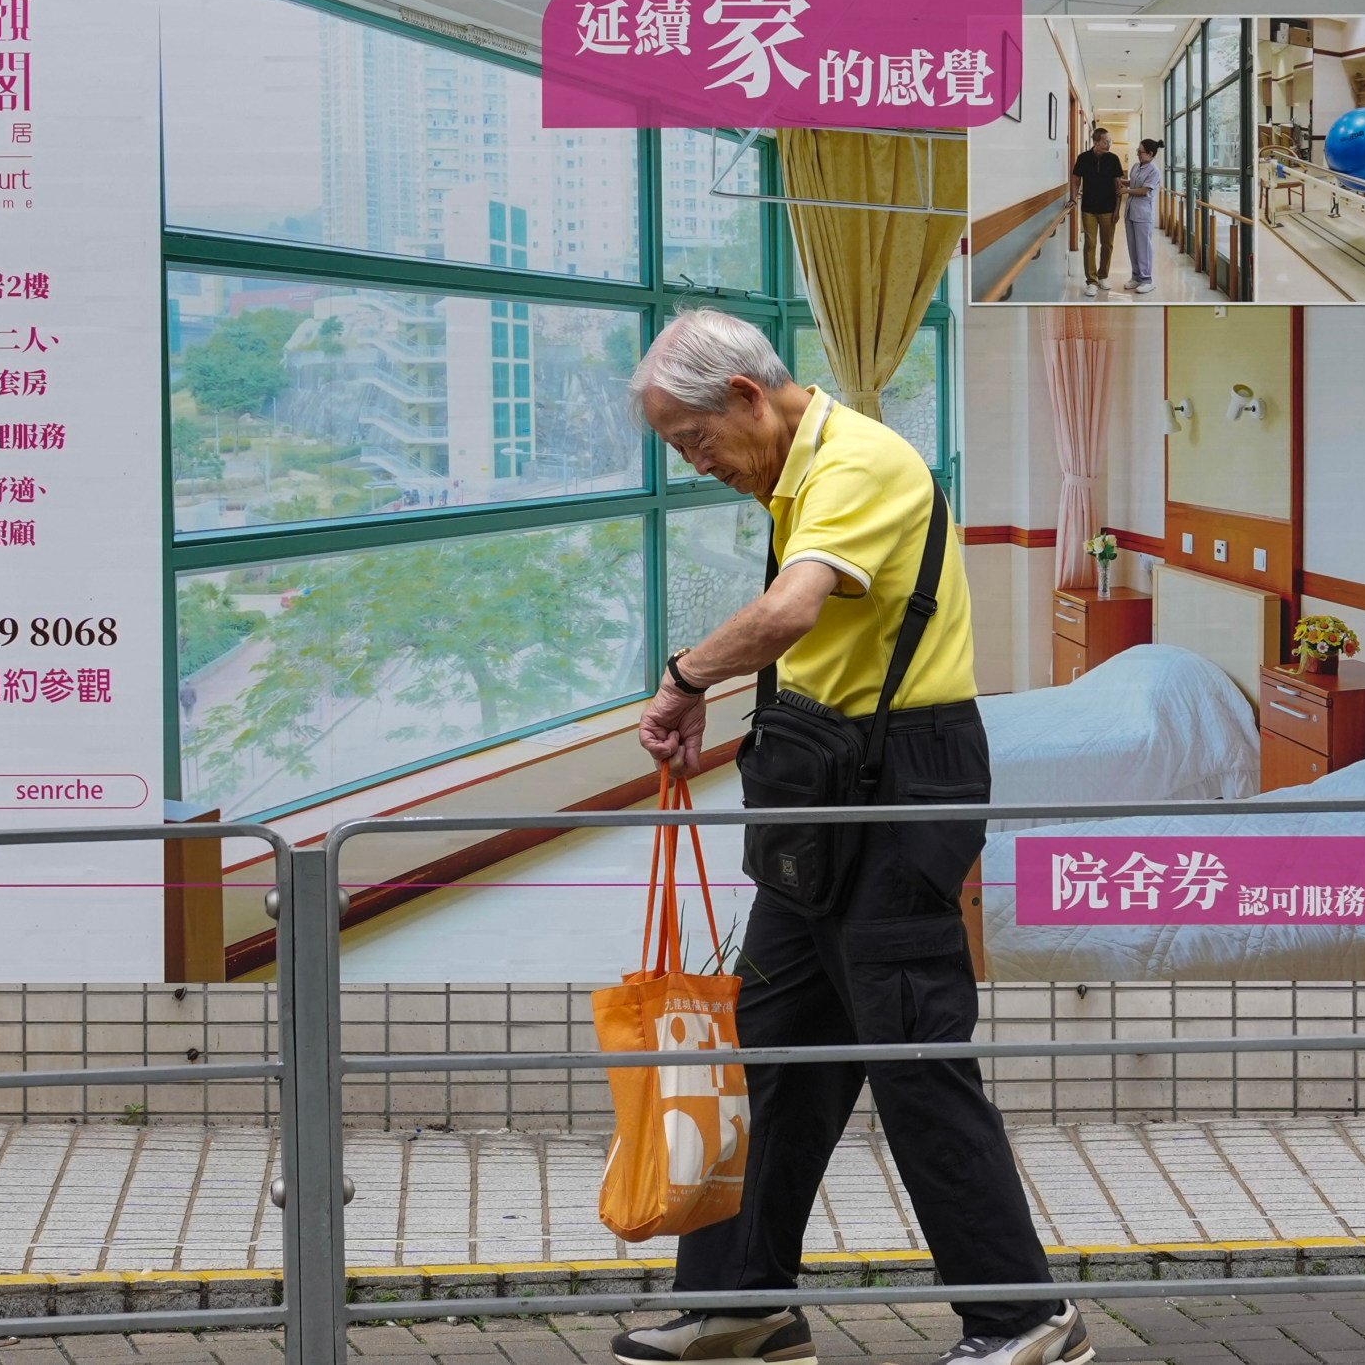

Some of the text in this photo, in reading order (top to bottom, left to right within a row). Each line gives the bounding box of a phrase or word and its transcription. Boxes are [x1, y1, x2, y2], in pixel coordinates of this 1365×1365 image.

[30, 617, 118, 646] 8068
[16, 780, 103, 801] senrche
[1051, 851, 1229, 911] 院舍券
